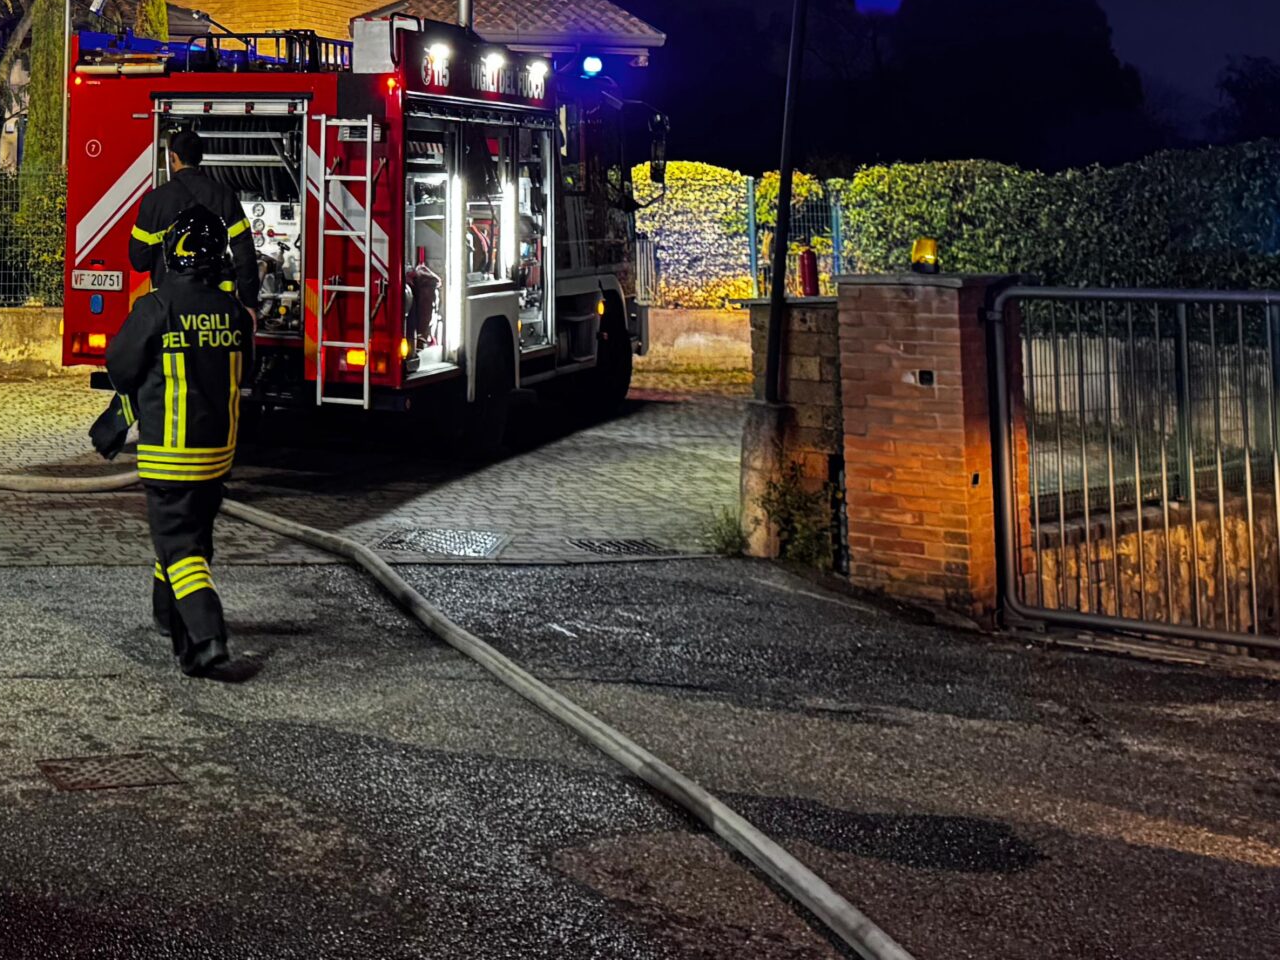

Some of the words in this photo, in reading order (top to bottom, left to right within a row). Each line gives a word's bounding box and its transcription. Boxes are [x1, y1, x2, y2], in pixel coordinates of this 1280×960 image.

[500, 68, 516, 95] DEL
[74, 273, 86, 286] VF
[91, 273, 120, 287] 20751
[180, 313, 230, 330] VIGILI
